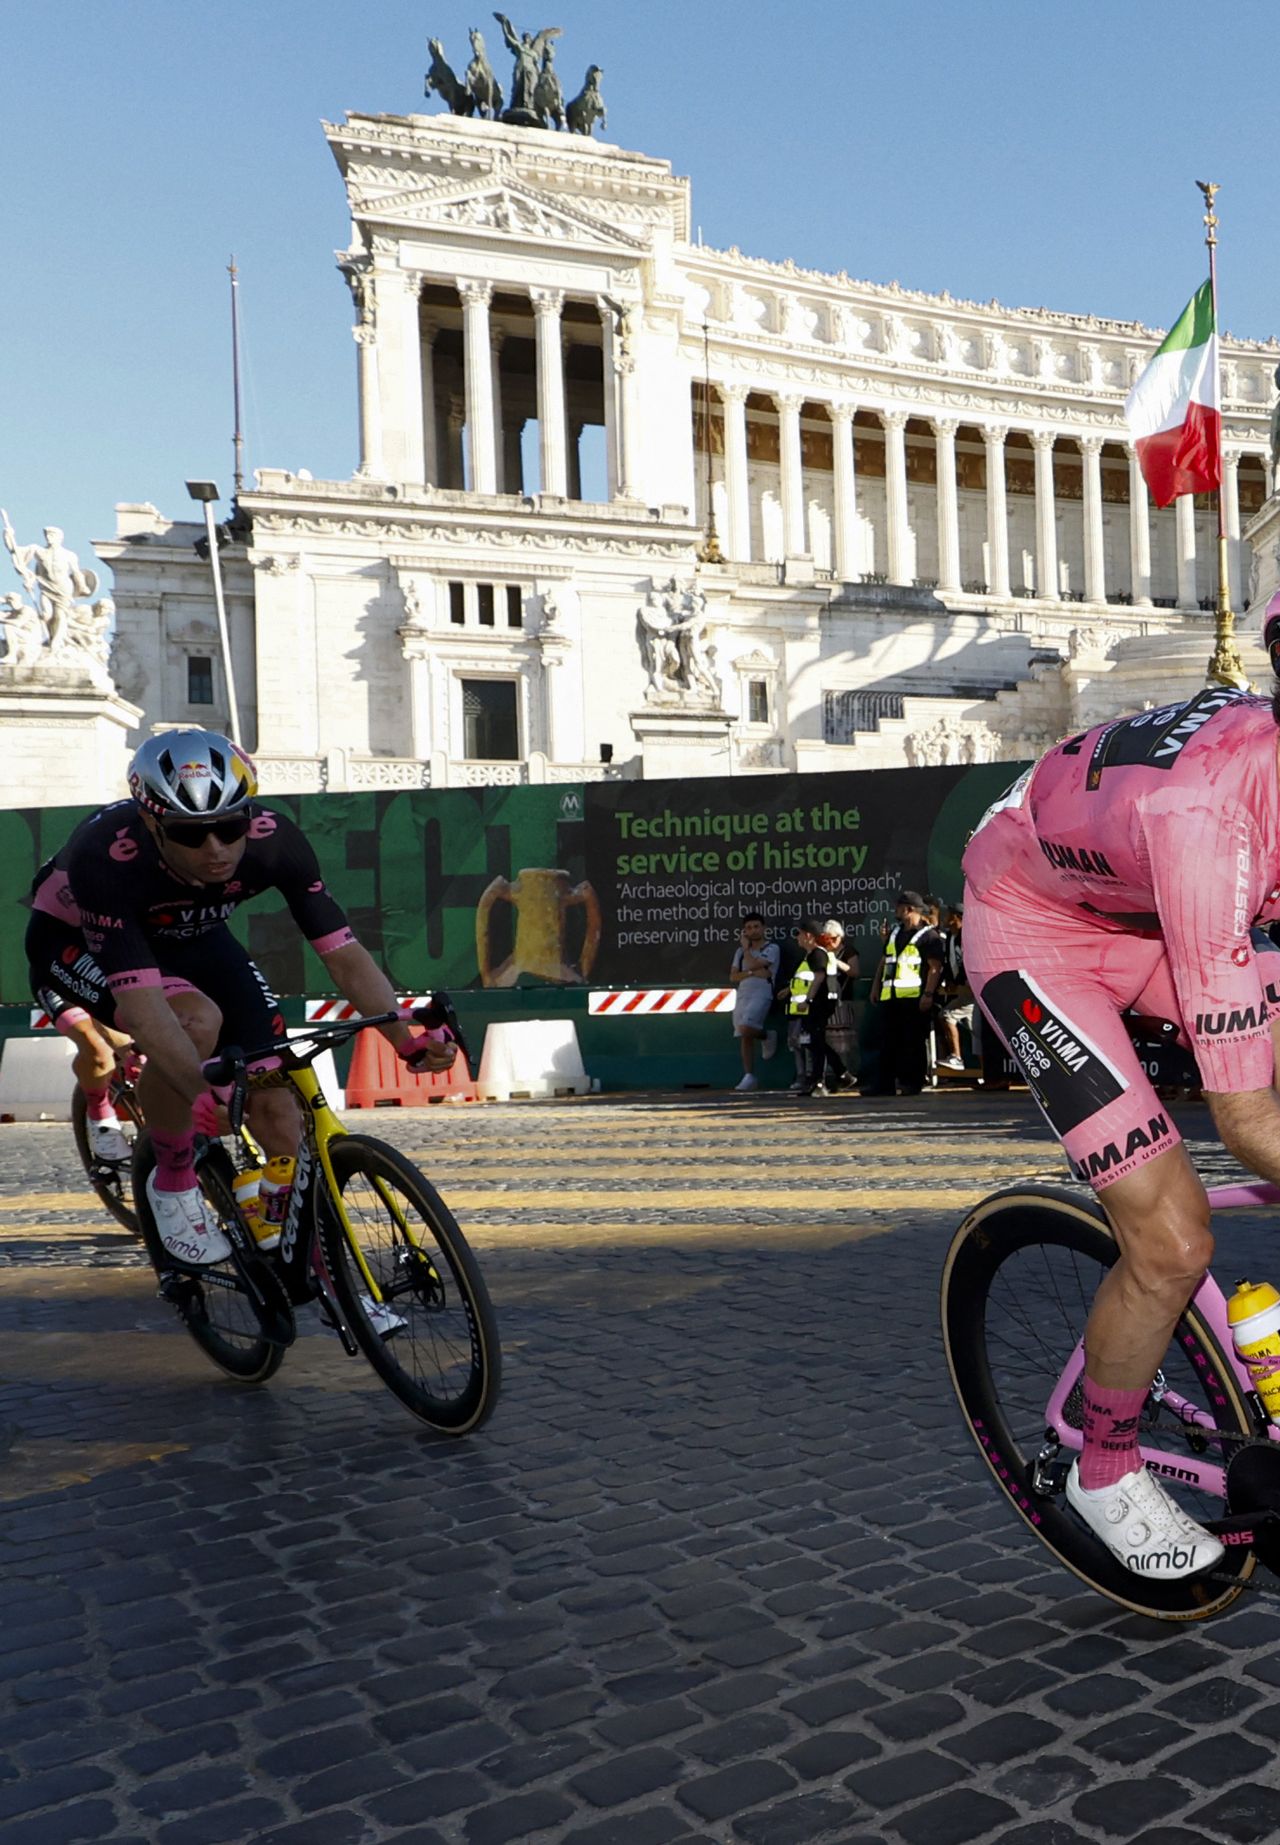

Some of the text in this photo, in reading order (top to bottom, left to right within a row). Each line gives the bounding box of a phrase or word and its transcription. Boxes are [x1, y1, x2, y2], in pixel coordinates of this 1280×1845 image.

[614, 802, 861, 843] Technique at the
[616, 841, 868, 875] service of history
[739, 876, 817, 899] top-down
[616, 905, 643, 922] the
[647, 902, 709, 921] method
[713, 900, 734, 919] for
[806, 898, 832, 916] the
[617, 927, 699, 949] preserving
[704, 924, 729, 943] the
[1016, 1026, 1051, 1070] lease
[1040, 1019, 1090, 1073] VISMA
[163, 1235, 207, 1262] nimbl
[1126, 1545, 1197, 1571] nimbl
